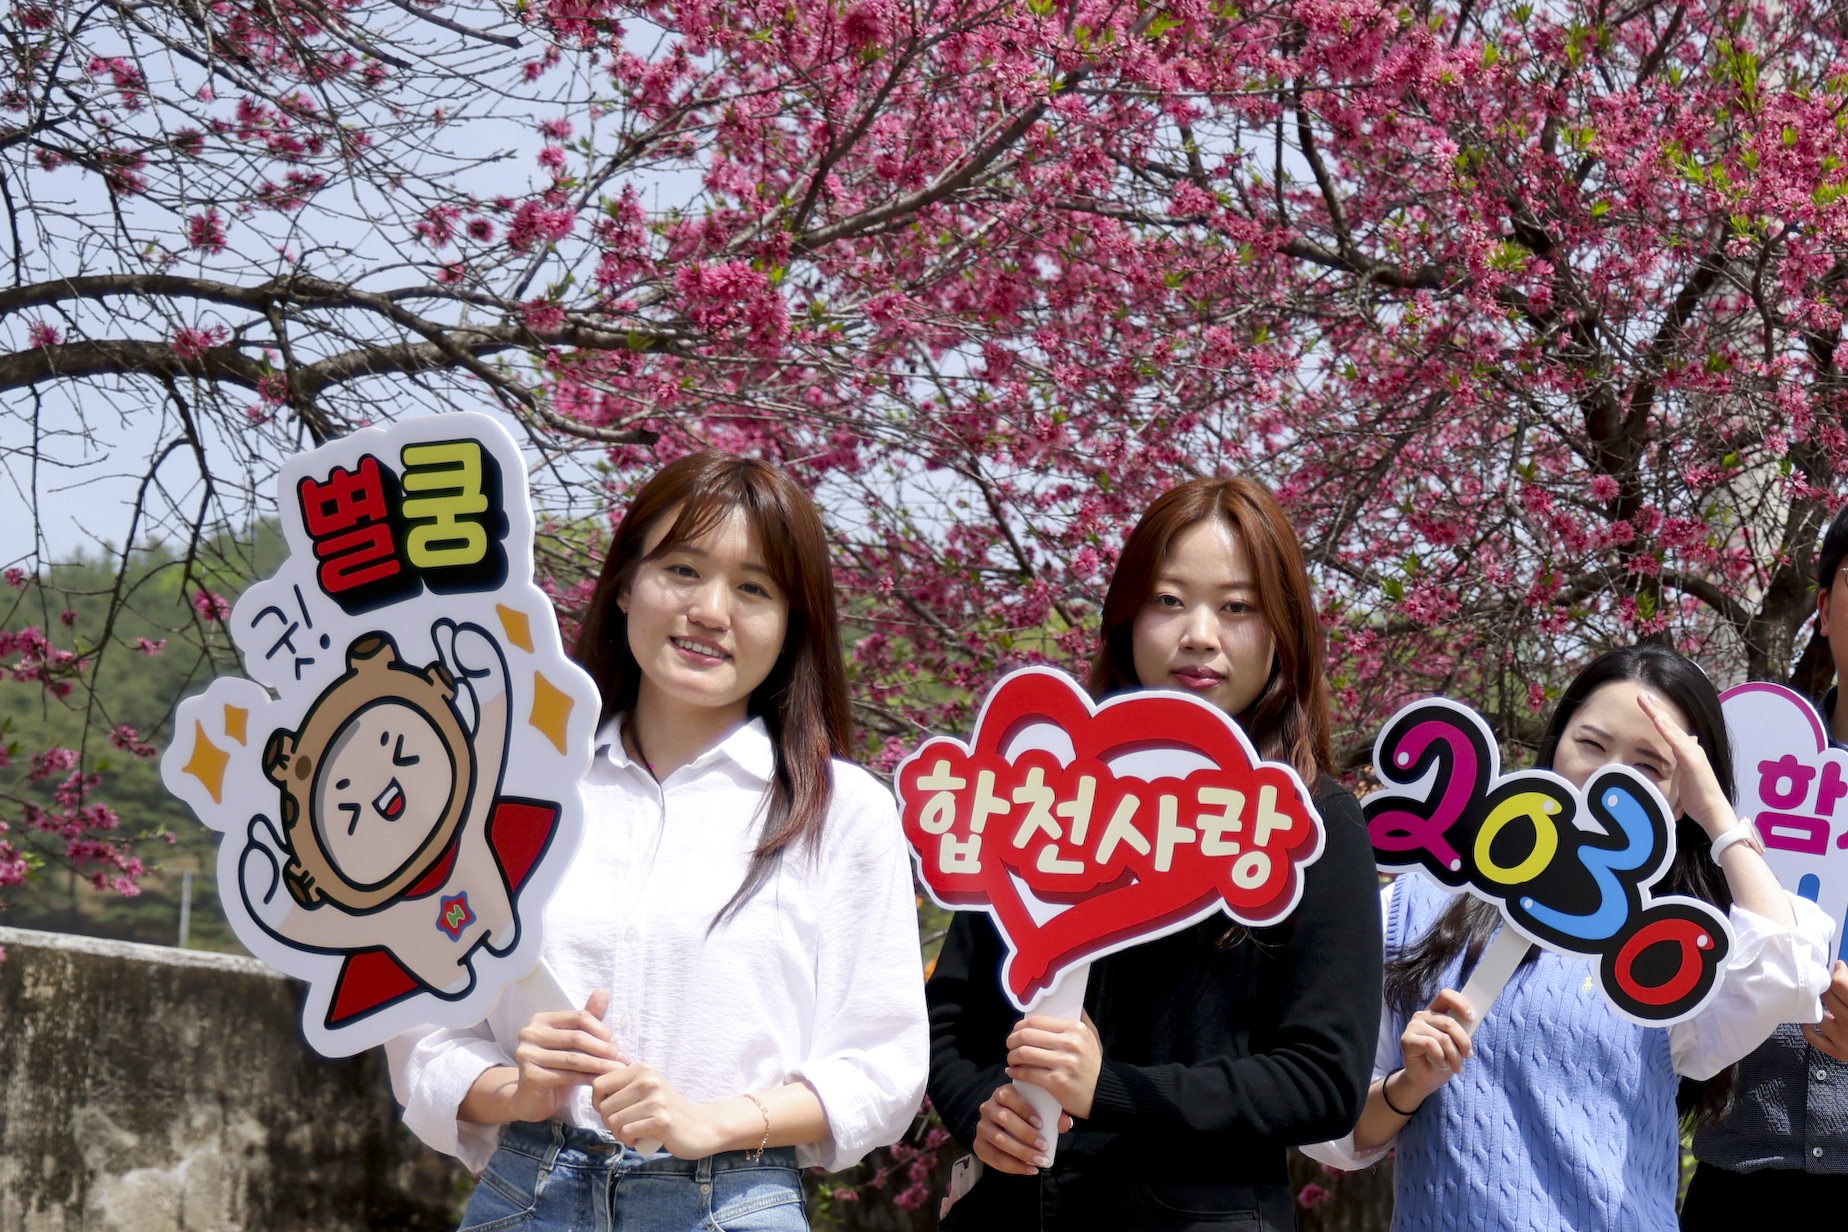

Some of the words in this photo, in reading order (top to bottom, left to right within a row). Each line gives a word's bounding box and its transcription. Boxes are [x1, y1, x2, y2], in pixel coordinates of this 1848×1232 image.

[298, 438, 497, 600] 별쿵
[916, 760, 1293, 890] 합천사랑
[1369, 720, 1715, 1006] 2030
